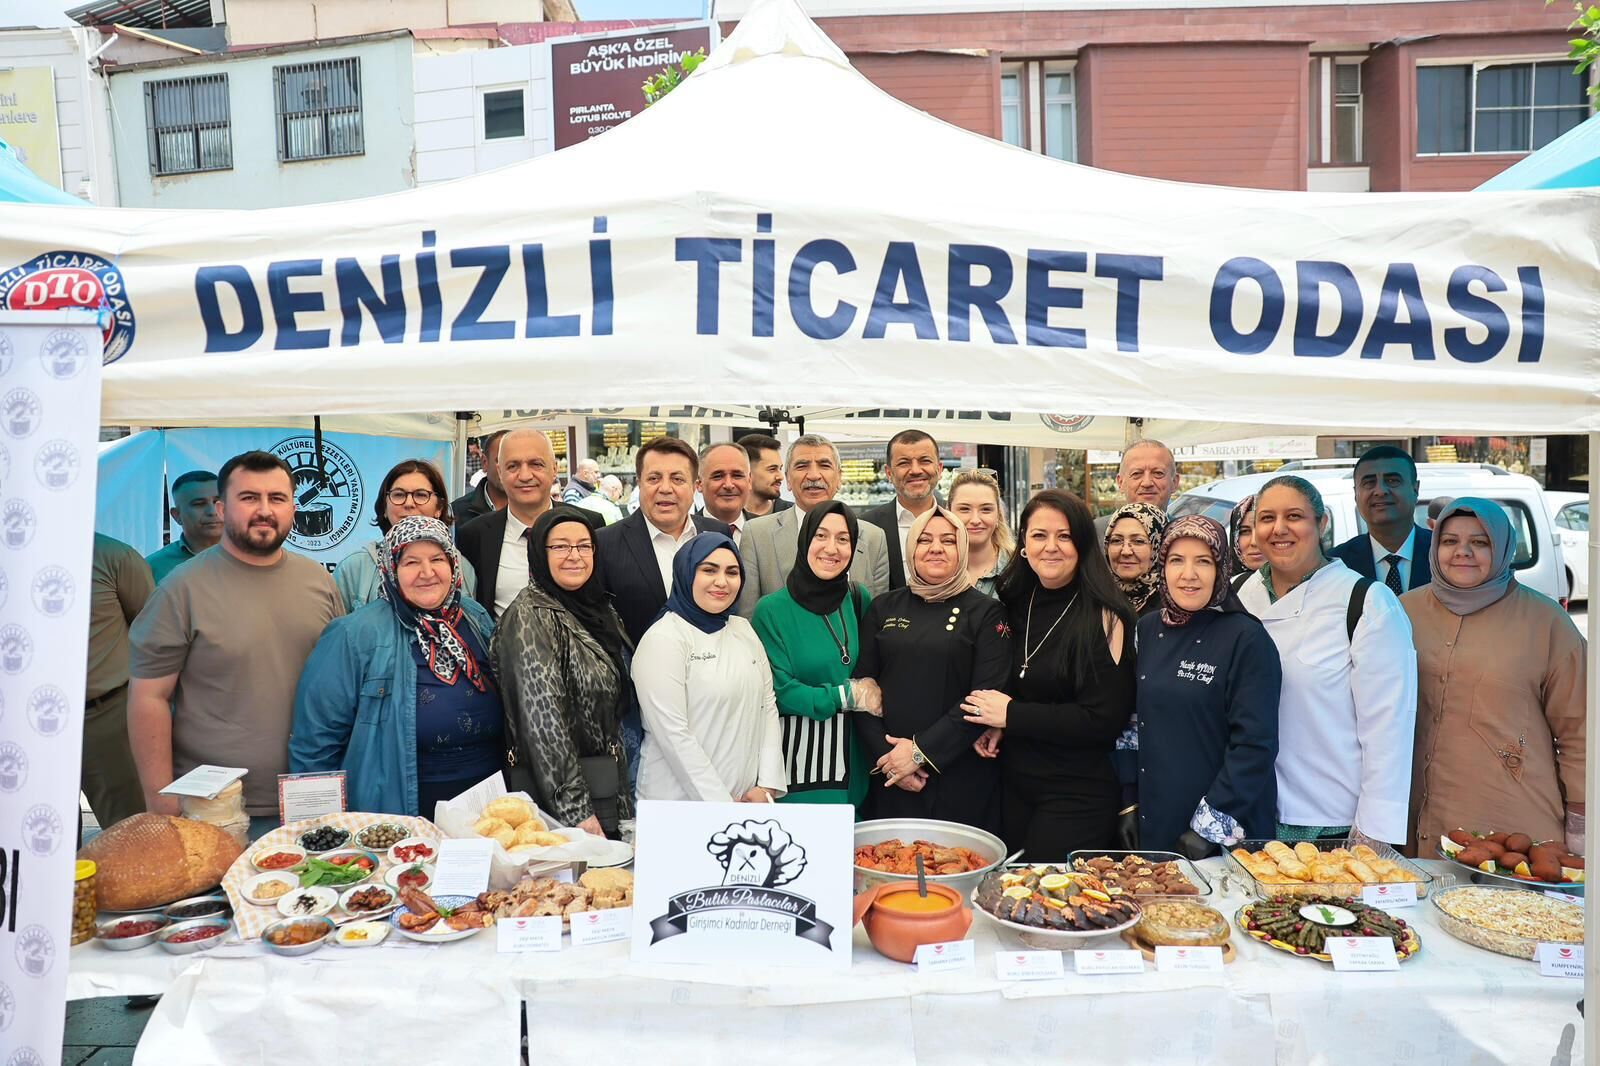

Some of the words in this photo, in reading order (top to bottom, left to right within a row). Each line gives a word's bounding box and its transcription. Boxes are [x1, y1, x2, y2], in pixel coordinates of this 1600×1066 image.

[587, 43, 632, 59] AŞK'A
[634, 37, 673, 51] ÖZEL
[570, 56, 625, 74] BÜYÜK
[570, 103, 615, 115] PIRLANTA
[570, 114, 601, 124] LOTUS
[601, 110, 631, 120] KOLYE
[24, 273, 97, 306] DTO
[36, 254, 109, 272] TİCARET
[102, 271, 133, 326] ODASI
[195, 215, 614, 353] DENİZLİ
[675, 213, 1163, 353] TİCARET
[1209, 256, 1545, 363] ODASI
[277, 441, 314, 456] KÜLTÜREL
[320, 444, 355, 479] EZZETLERİ
[1197, 673, 1215, 684] Chef
[730, 873, 761, 883] DENİZLİ
[686, 892, 729, 911] Butik
[732, 888, 799, 913] Pastacılar
[689, 917, 724, 931] Girişimci
[725, 918, 759, 930] Kadınlar
[760, 919, 792, 933] Derneği
